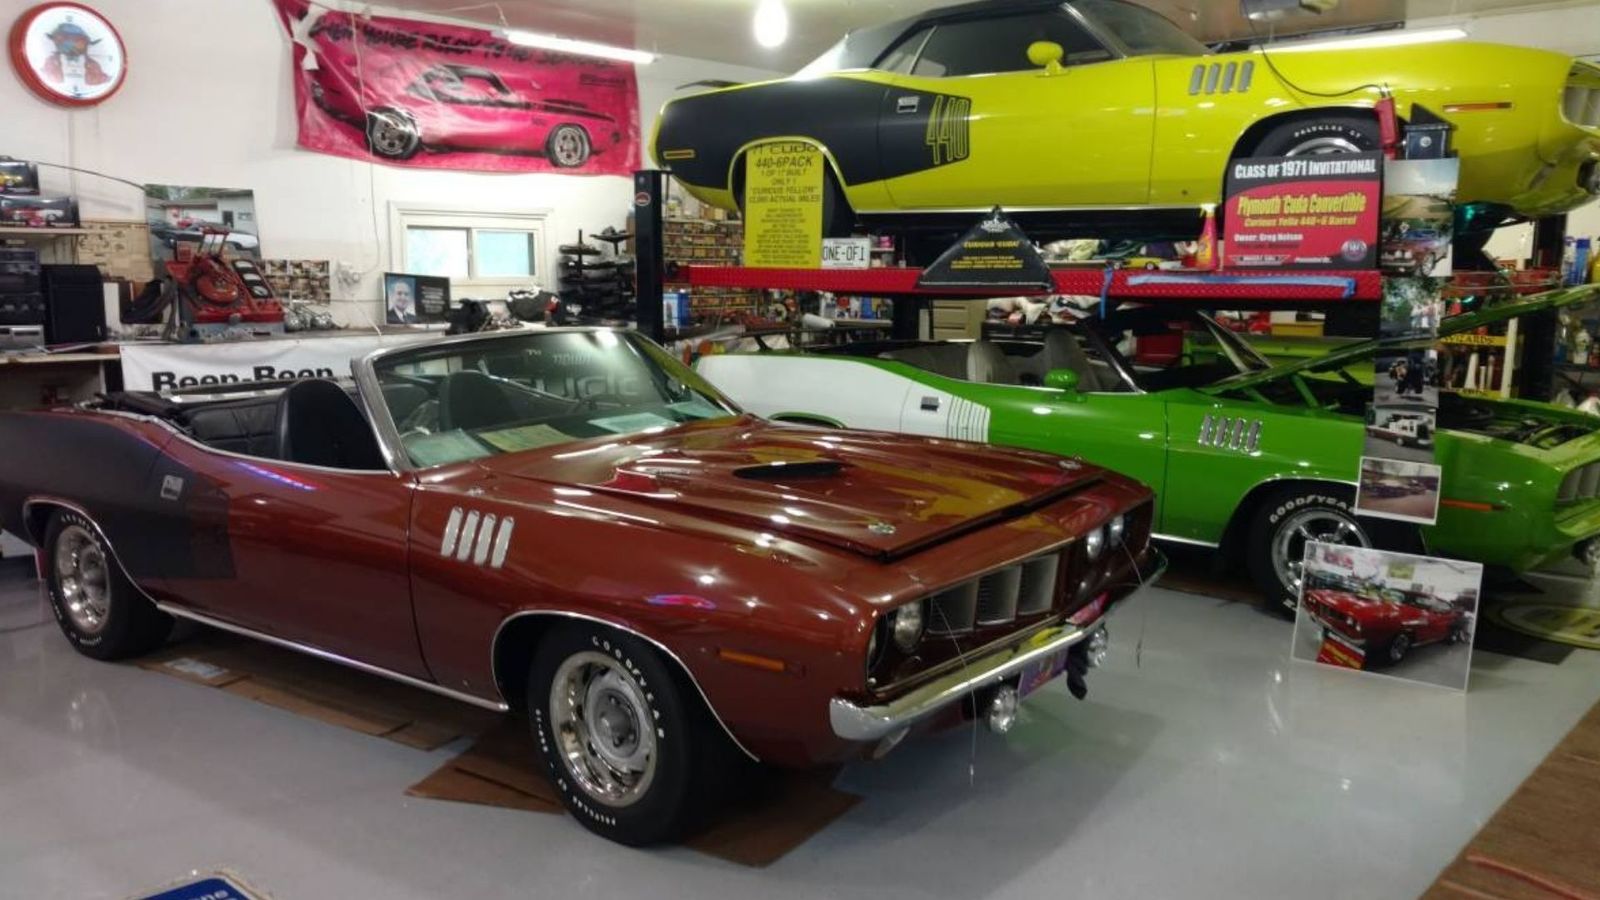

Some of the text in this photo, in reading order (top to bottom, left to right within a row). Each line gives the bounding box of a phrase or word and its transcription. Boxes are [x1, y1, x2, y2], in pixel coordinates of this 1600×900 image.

[926, 95, 970, 165] 440
[1281, 160, 1307, 176] 1971
[1308, 158, 1376, 175] INVITATIONAL
[1237, 195, 1281, 217] Plymouth
[1309, 192, 1366, 213] Convertible
